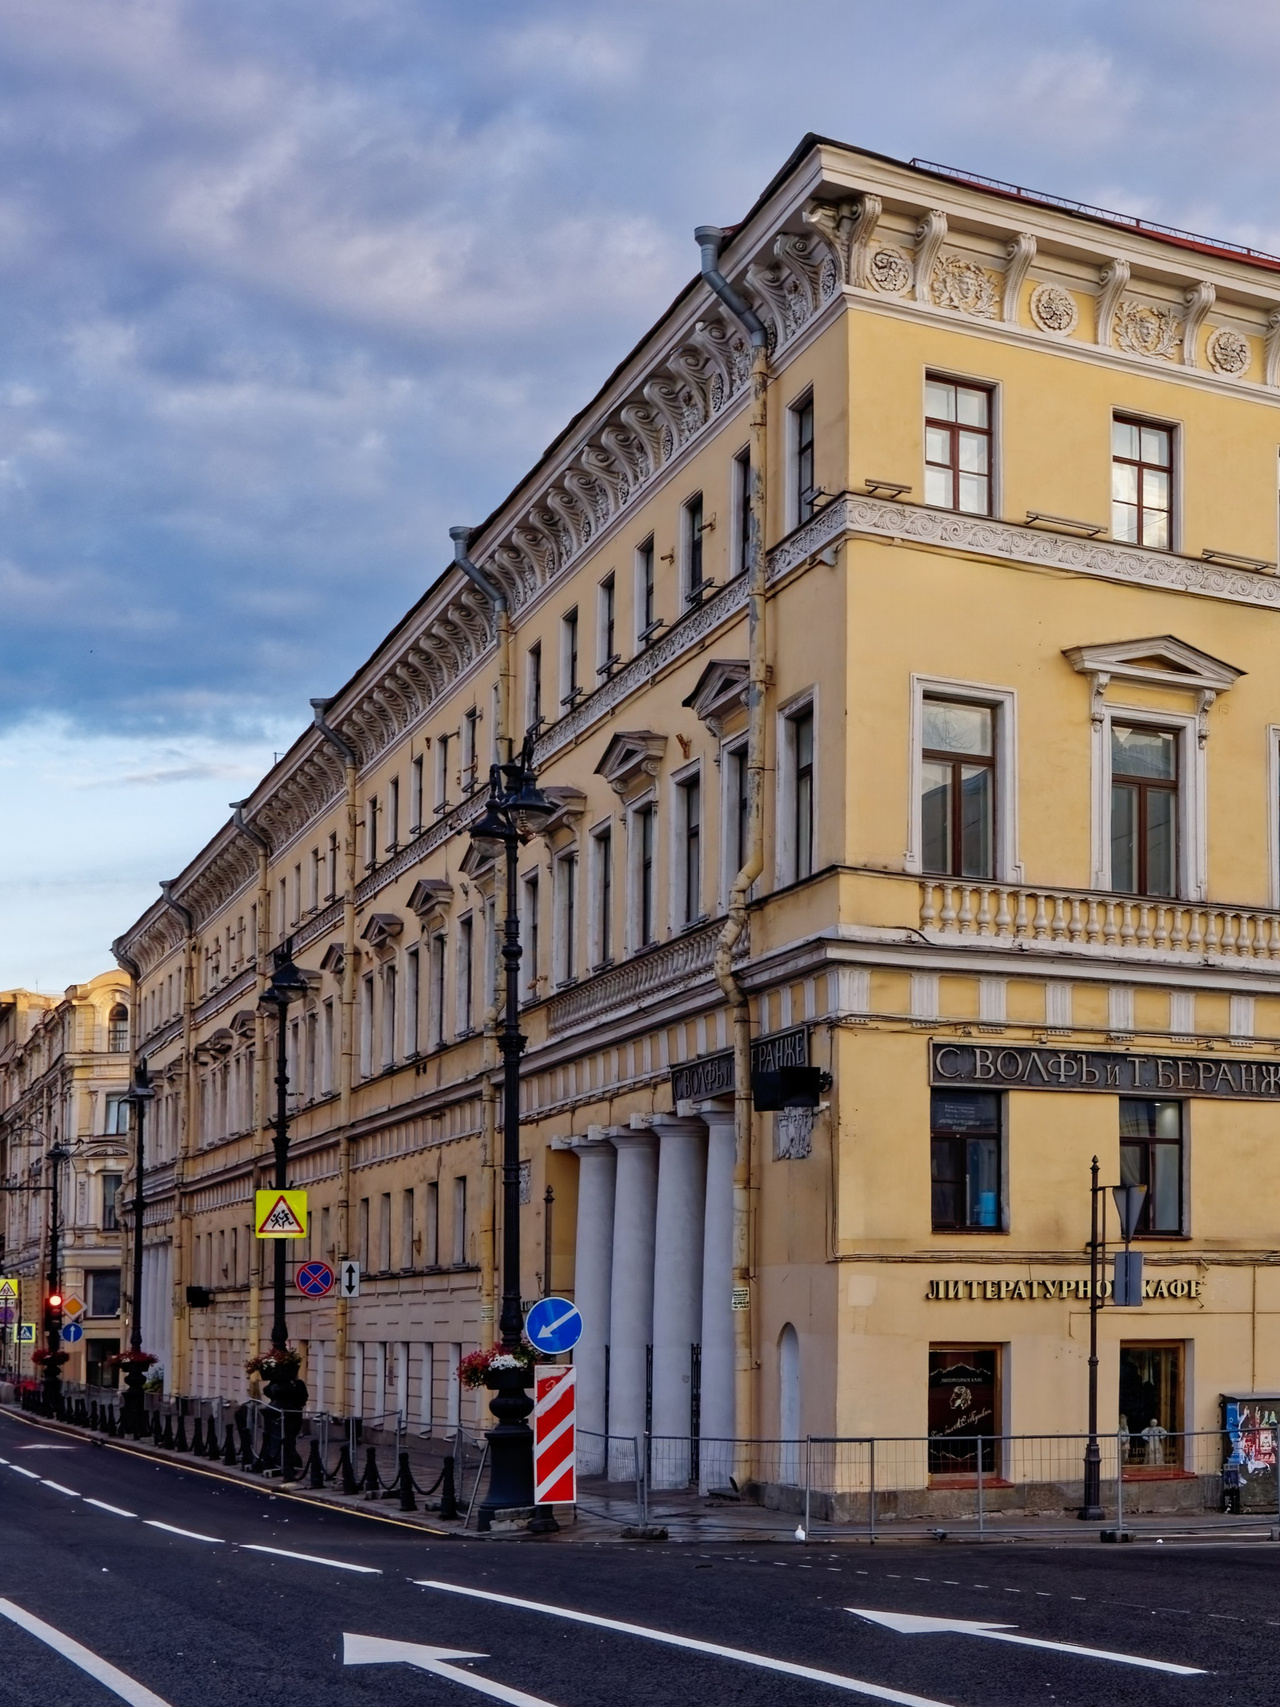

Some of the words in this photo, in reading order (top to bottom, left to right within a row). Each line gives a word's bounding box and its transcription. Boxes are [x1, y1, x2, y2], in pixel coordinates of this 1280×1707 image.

[683, 1060, 724, 1099] ВОЛФЪ
[750, 1033, 805, 1073] ЕРАНЖЕ
[935, 1047, 965, 1079] С.
[972, 1047, 1100, 1085] ВОЛФЪ
[1126, 1056, 1149, 1088] Т.
[925, 1279, 1114, 1300] ЛИТЕРАТУРНО
[1141, 1279, 1201, 1299] КАФЕ
